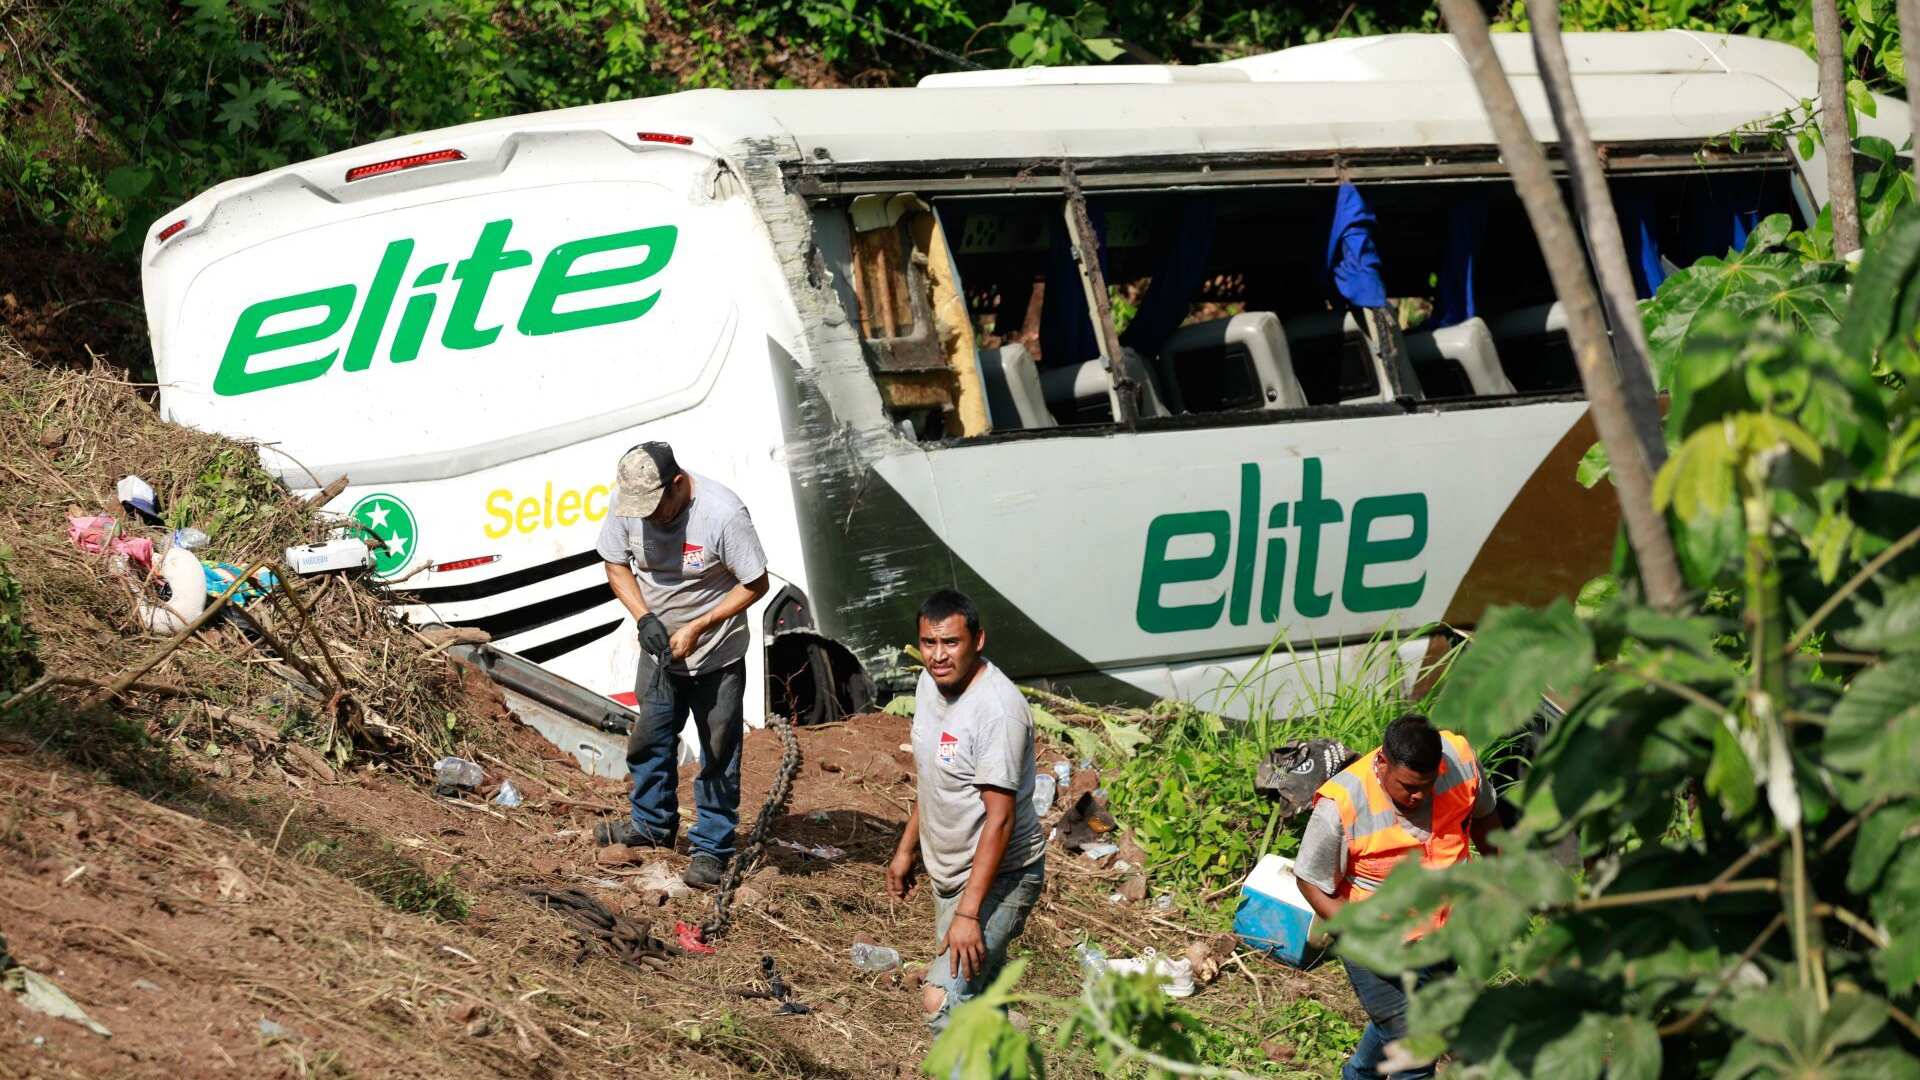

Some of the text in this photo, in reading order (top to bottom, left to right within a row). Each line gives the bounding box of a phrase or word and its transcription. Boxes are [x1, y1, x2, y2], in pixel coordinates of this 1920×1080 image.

[213, 219, 678, 397] elite
[483, 479, 617, 540] Selec
[1136, 457, 1429, 634] elite
